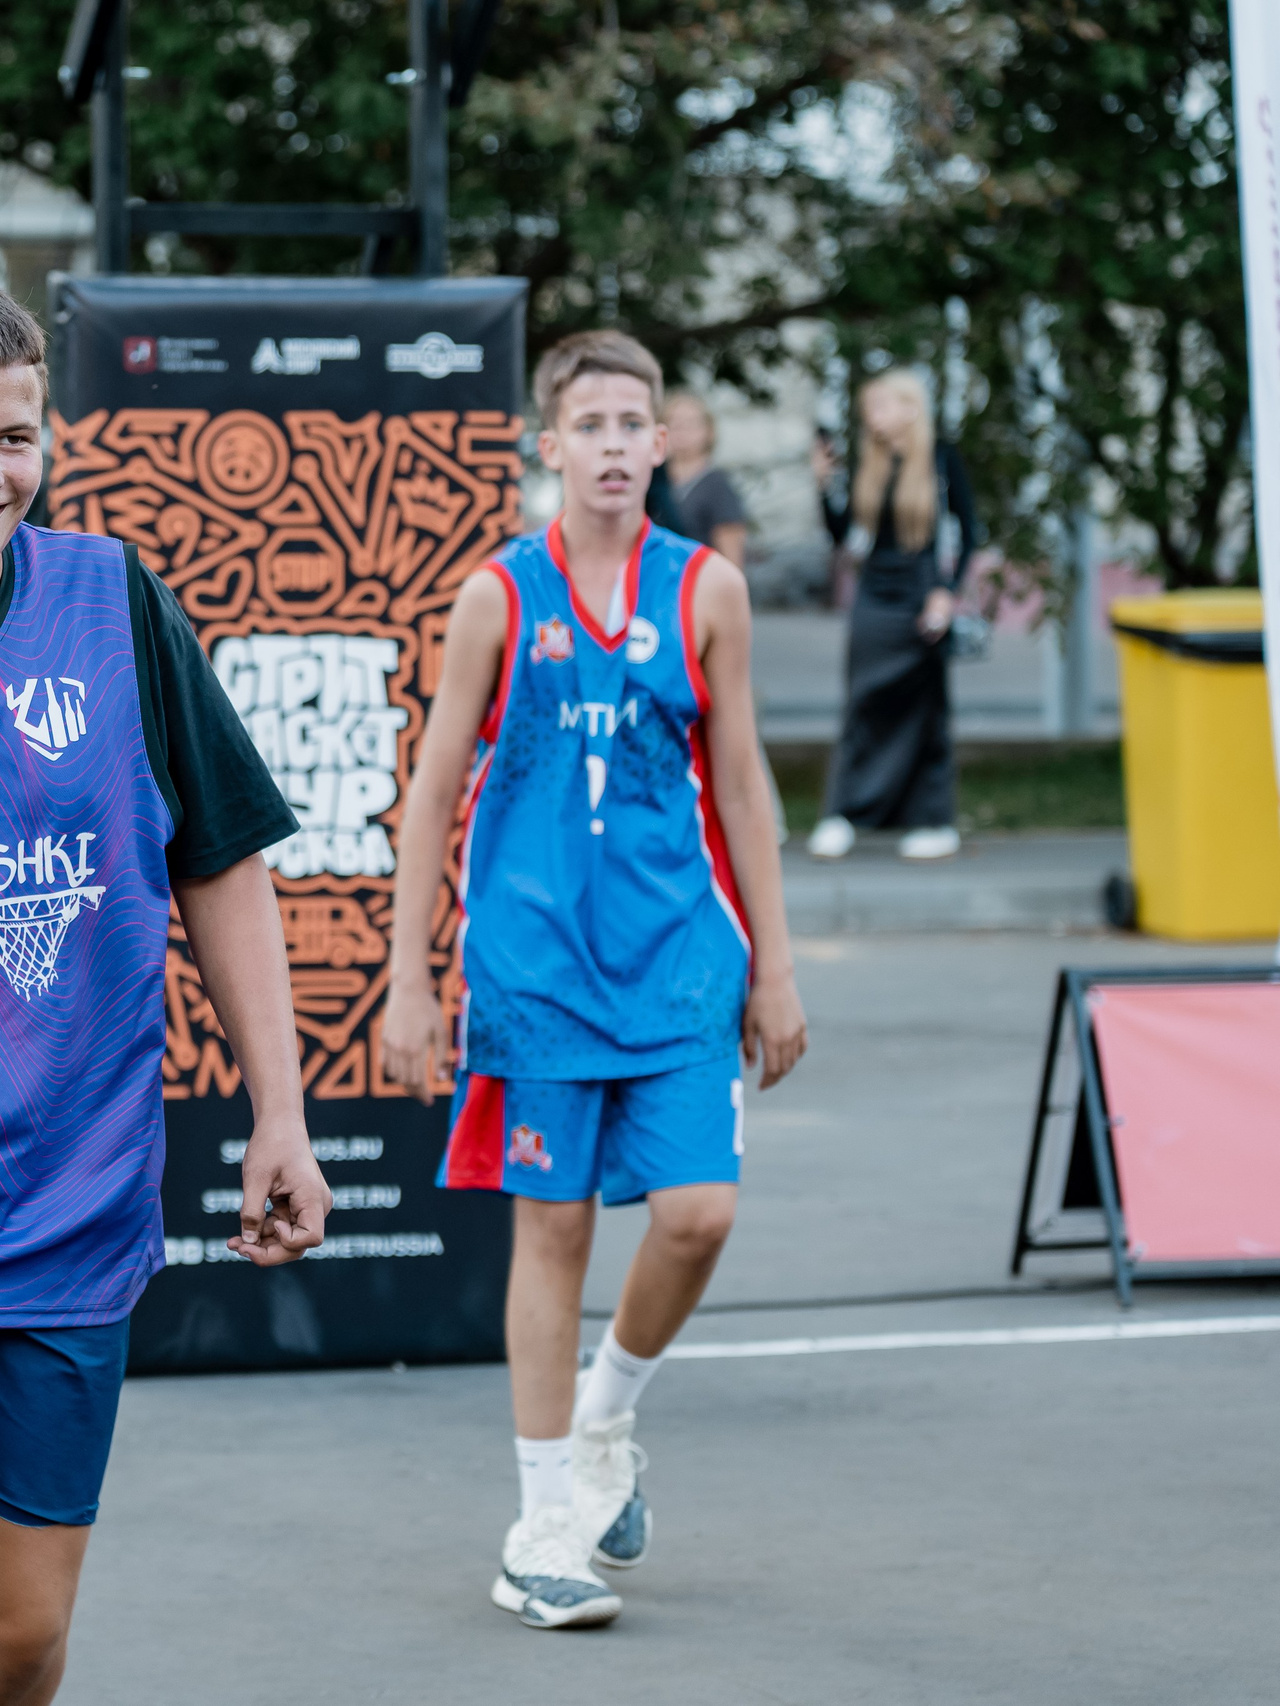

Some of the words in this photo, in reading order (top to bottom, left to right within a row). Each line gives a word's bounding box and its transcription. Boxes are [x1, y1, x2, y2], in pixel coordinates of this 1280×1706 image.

[243, 705, 409, 772] АСКЕТ
[273, 770, 399, 830] УР
[261, 823, 397, 879] СКВА
